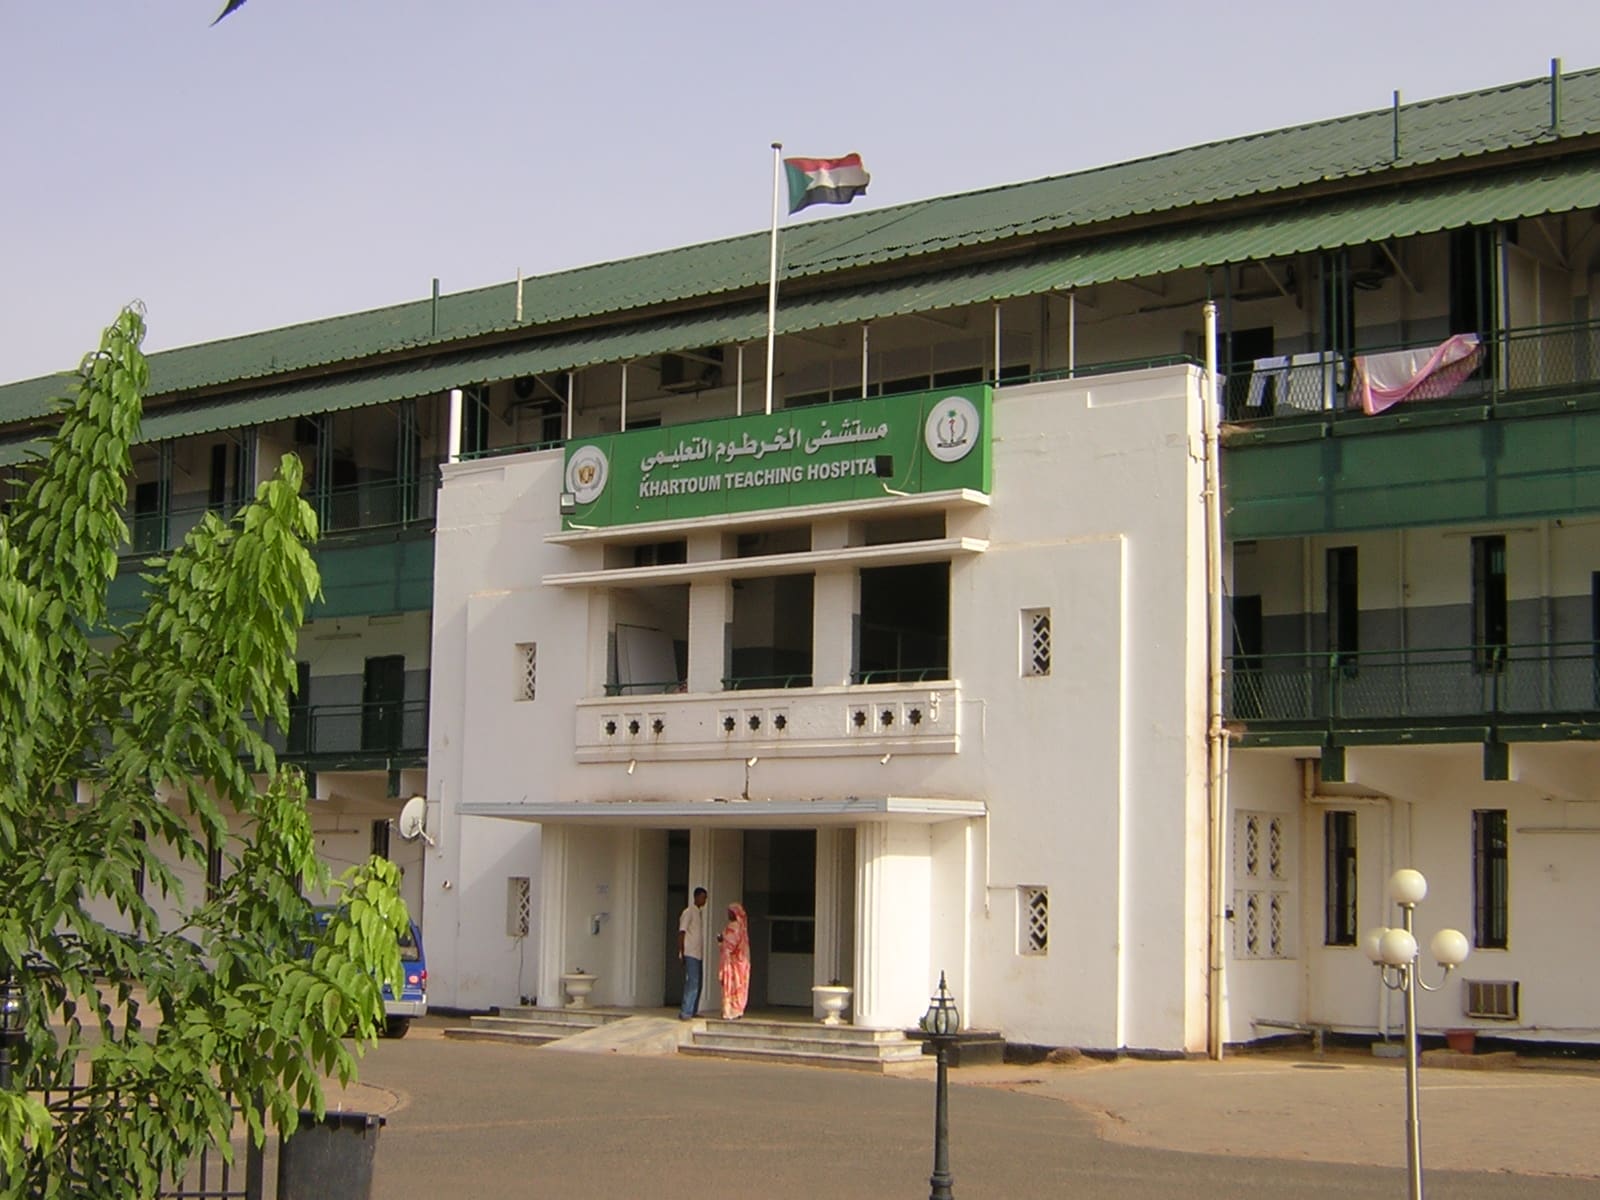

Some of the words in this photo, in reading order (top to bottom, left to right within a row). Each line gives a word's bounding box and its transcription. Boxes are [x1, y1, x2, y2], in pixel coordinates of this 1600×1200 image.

[715, 427, 802, 464] الخرطوم
[805, 418, 889, 455] مستشفى
[639, 477, 721, 498] KHARTOUM
[725, 465, 803, 489] TEACHING
[808, 457, 877, 481] HOSPITA
[640, 437, 713, 481] التعليمي
